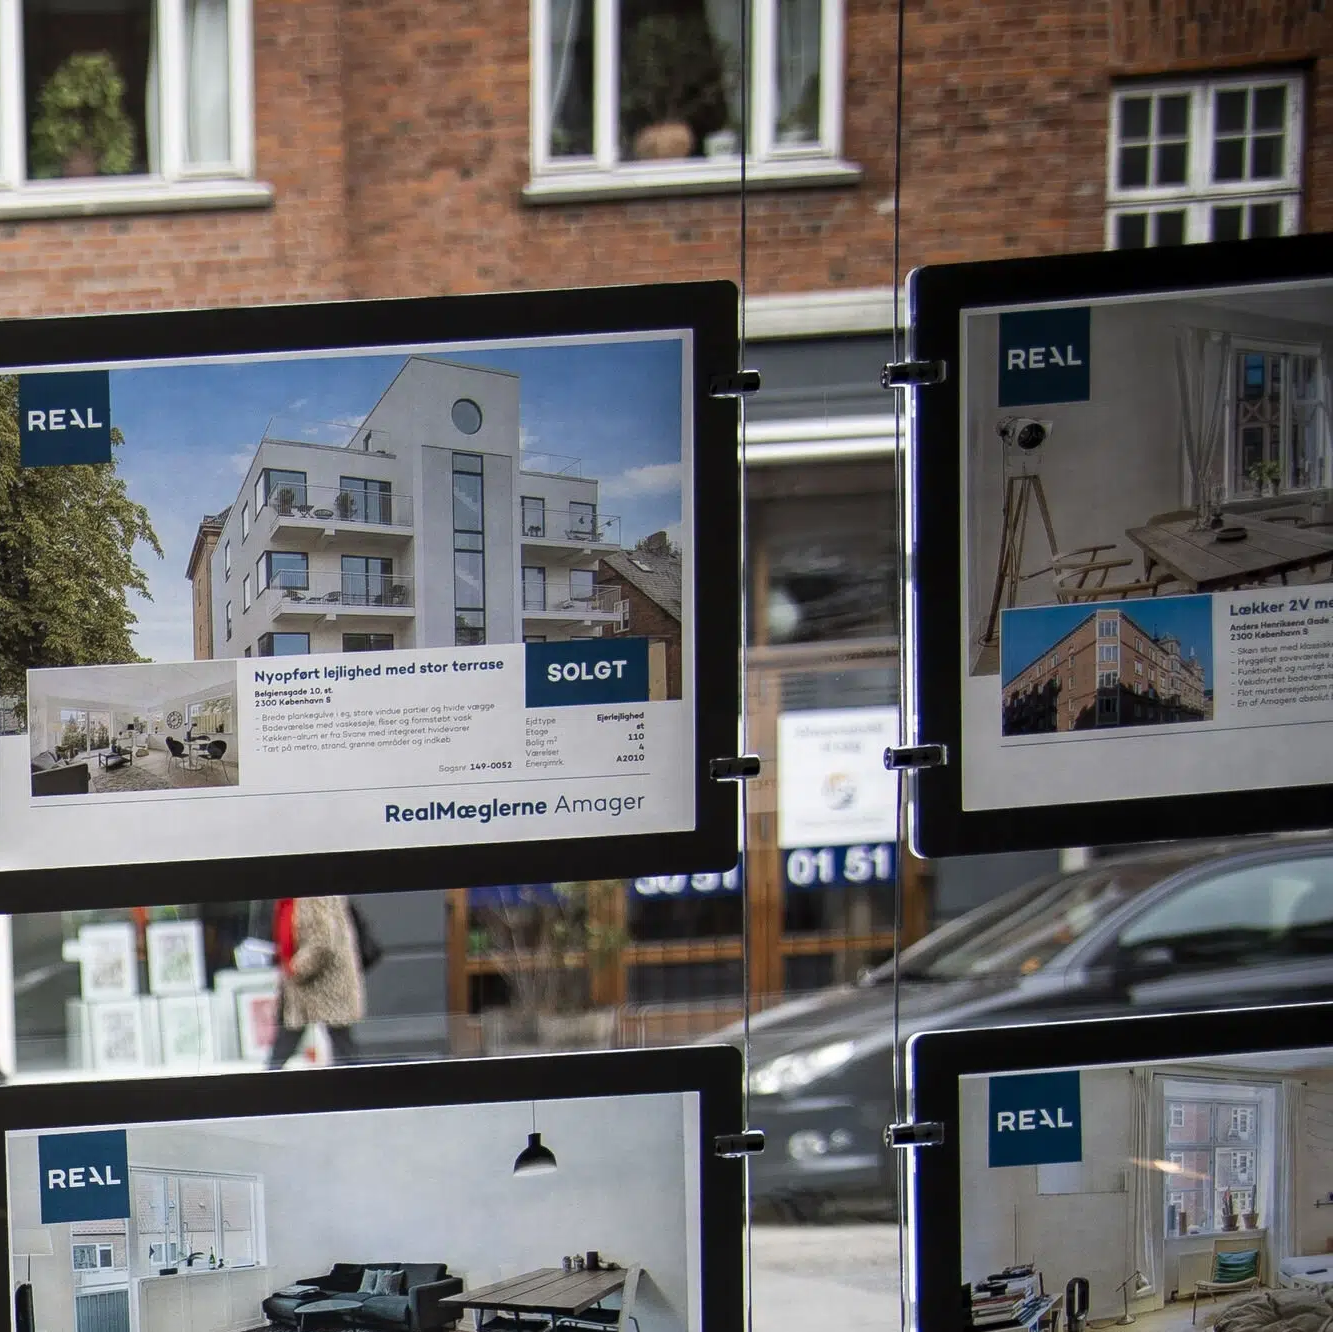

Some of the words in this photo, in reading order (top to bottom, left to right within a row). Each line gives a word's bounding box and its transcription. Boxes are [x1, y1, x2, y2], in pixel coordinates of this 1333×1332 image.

[1007, 344, 1082, 370] REAL
[27, 407, 103, 432] REAL
[1229, 601, 1284, 616] Lækker
[1288, 597, 1310, 611] 2V
[254, 667, 320, 685] Nyopført
[323, 663, 381, 681] lejlighed
[385, 661, 415, 675] med
[419, 661, 448, 674] stor
[451, 660, 504, 672] terrase
[547, 659, 627, 682] SOLGT
[254, 687, 308, 699] Belgiensgade
[469, 760, 512, 771] 149-0052
[385, 797, 547, 824] RealMæglerne
[554, 794, 645, 816] Amager
[844, 845, 892, 882] 51
[997, 1107, 1073, 1132] REAL
[48, 1165, 121, 1190] REAL
